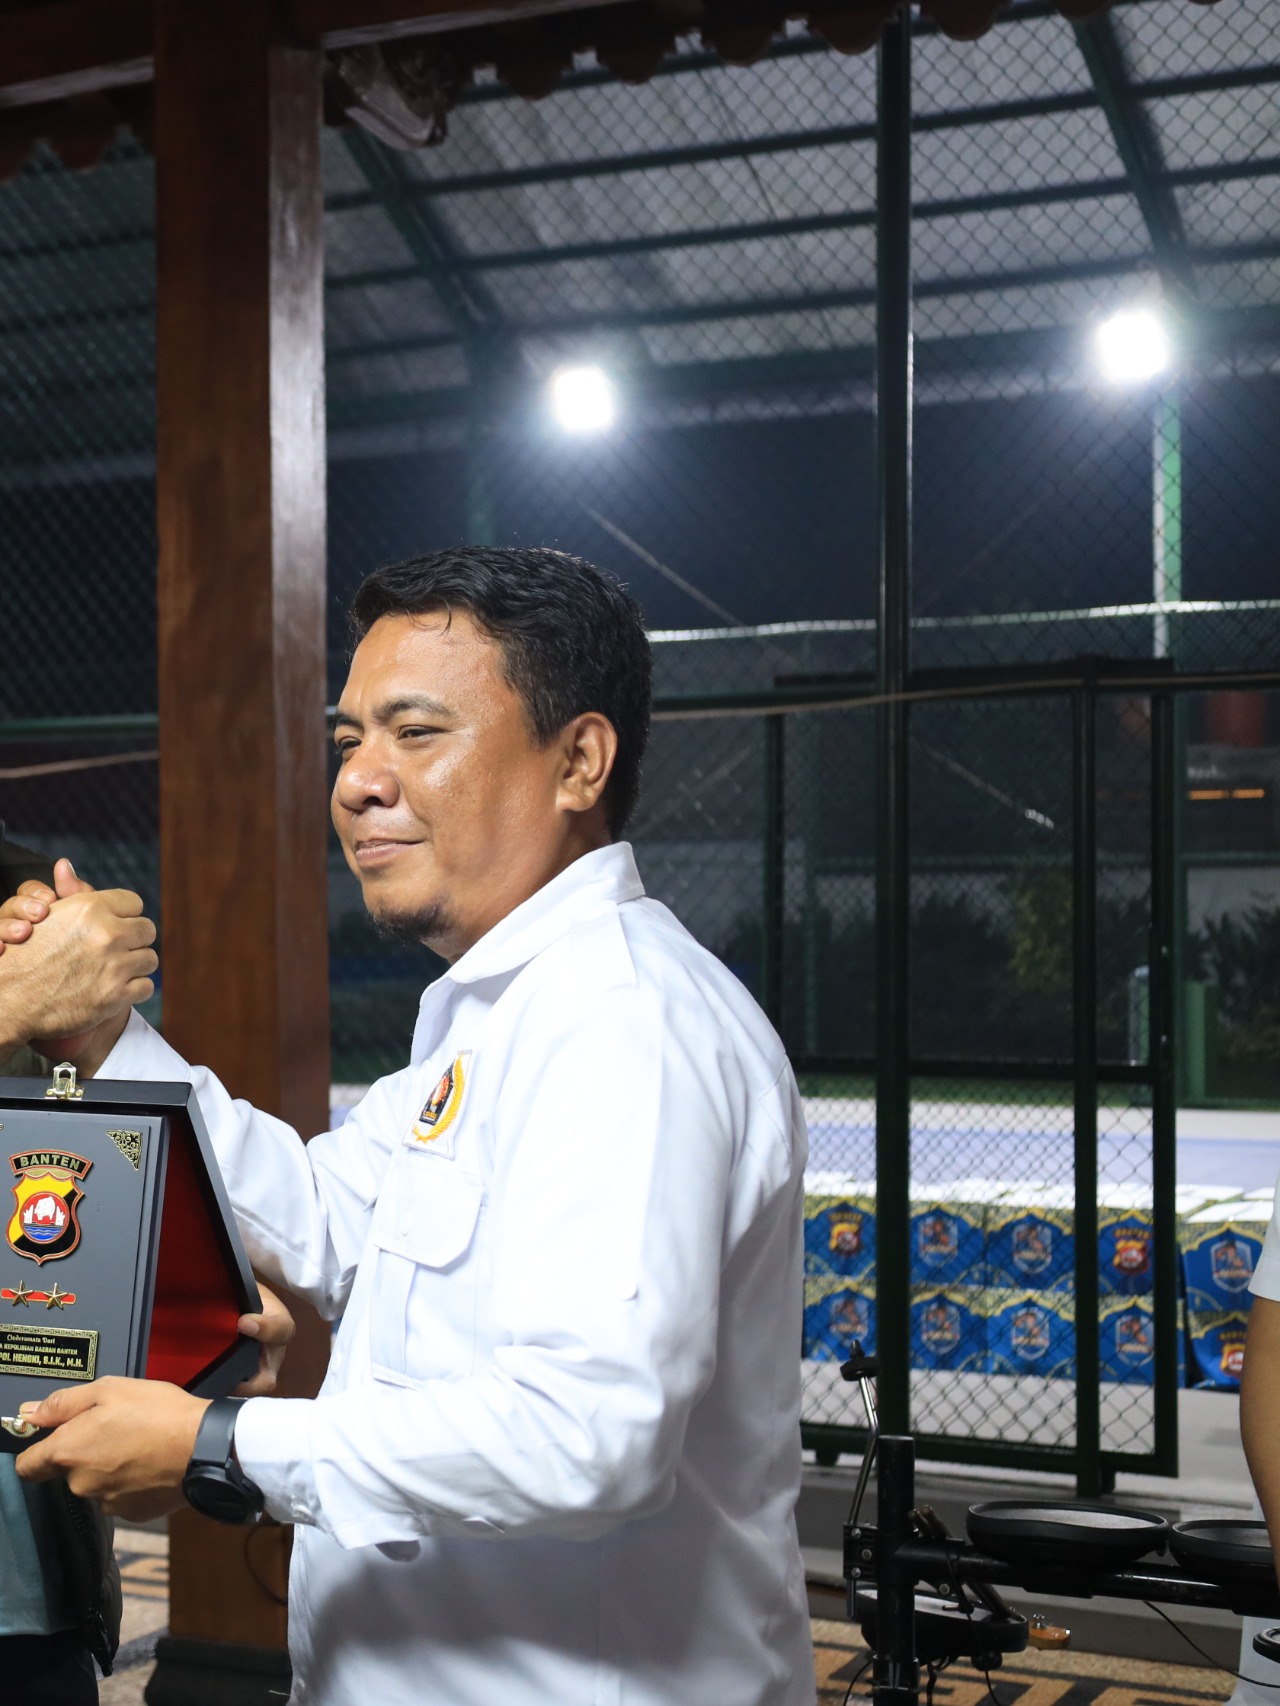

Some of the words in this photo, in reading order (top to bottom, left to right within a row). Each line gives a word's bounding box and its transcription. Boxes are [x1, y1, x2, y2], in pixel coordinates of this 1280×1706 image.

[20, 1154, 80, 1170] BANTEN
[4, 1343, 34, 1352] KEPOLISIAN
[35, 1346, 56, 1354] DAERAH
[13, 1353, 41, 1365] HENGKI,
[43, 1355, 65, 1367] S.I.K.,
[66, 1357, 83, 1367] M.H.
